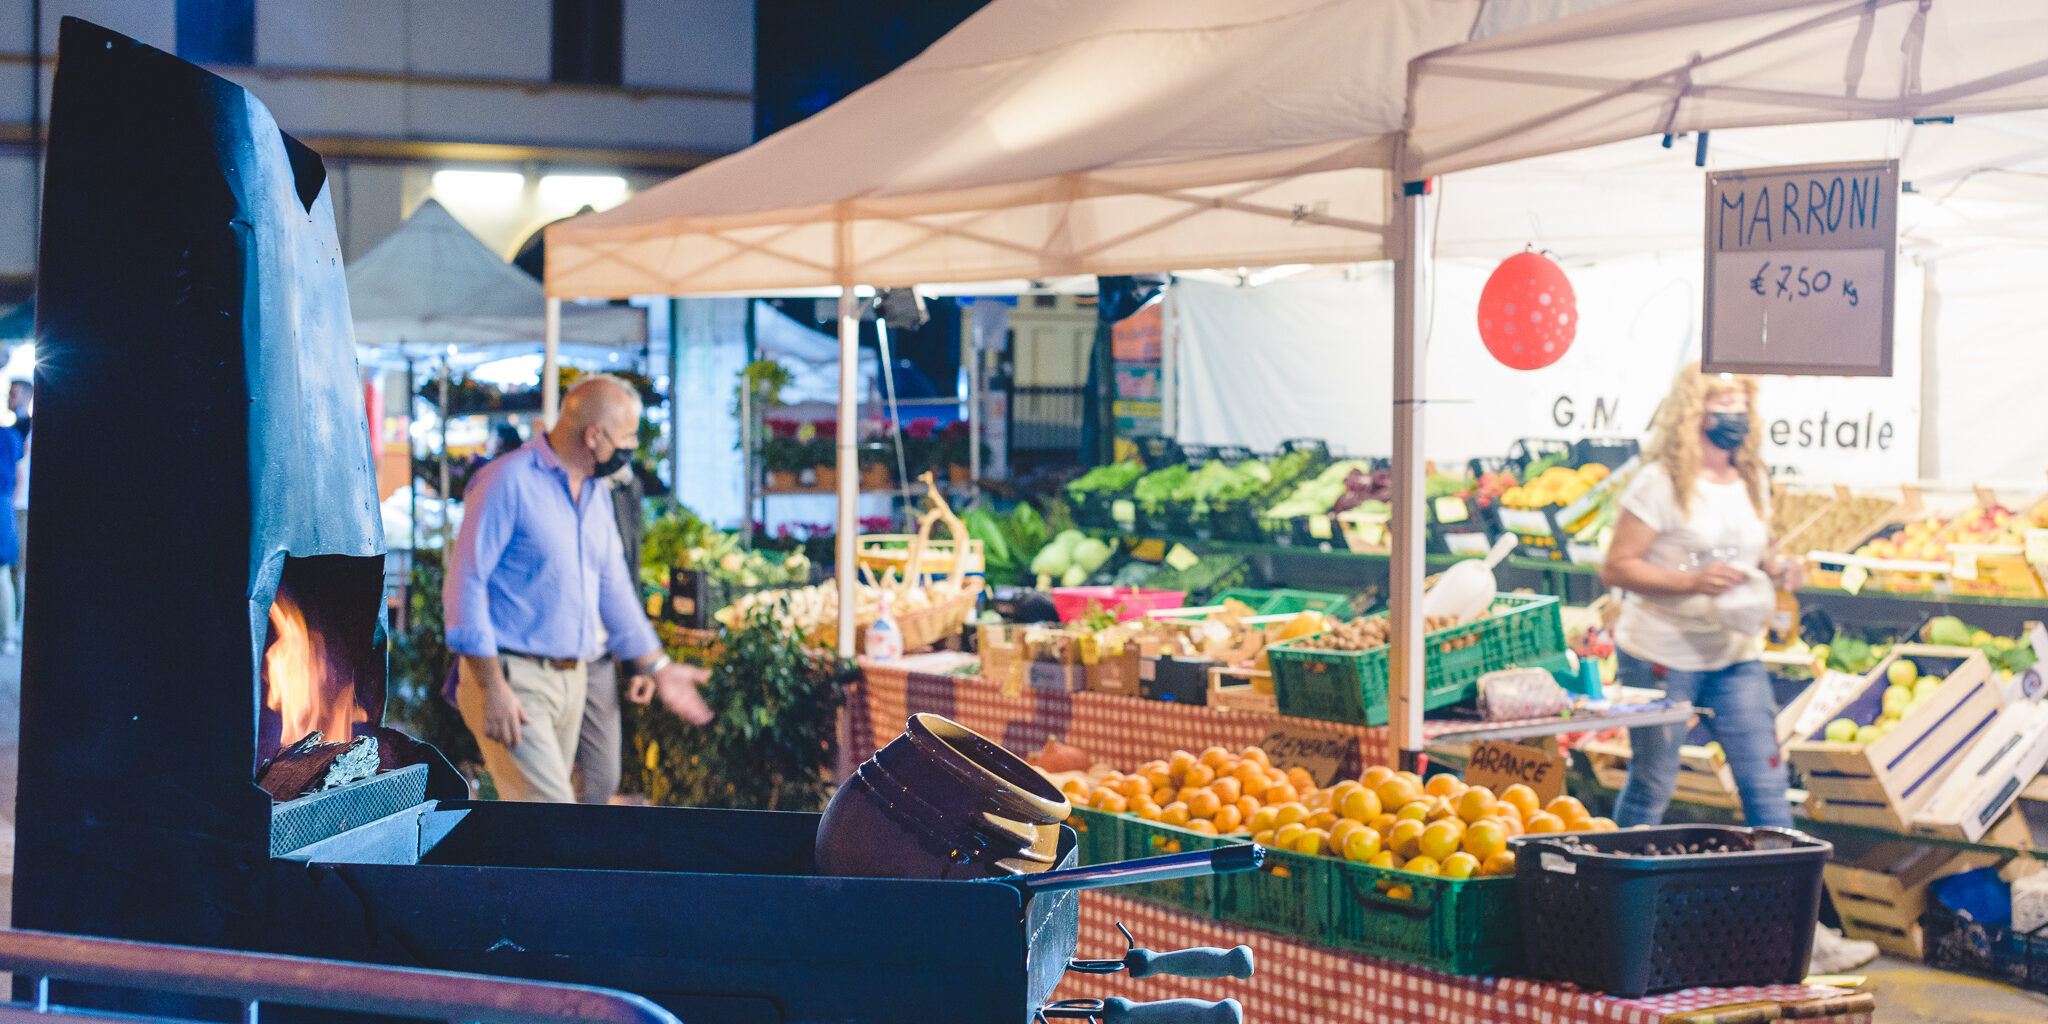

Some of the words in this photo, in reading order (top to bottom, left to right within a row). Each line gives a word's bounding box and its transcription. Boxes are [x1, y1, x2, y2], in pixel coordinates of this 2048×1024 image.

[1719, 175, 1880, 251] MARRONI
[1770, 410, 1894, 450] estale
[1471, 745, 1553, 783] ARANCE
